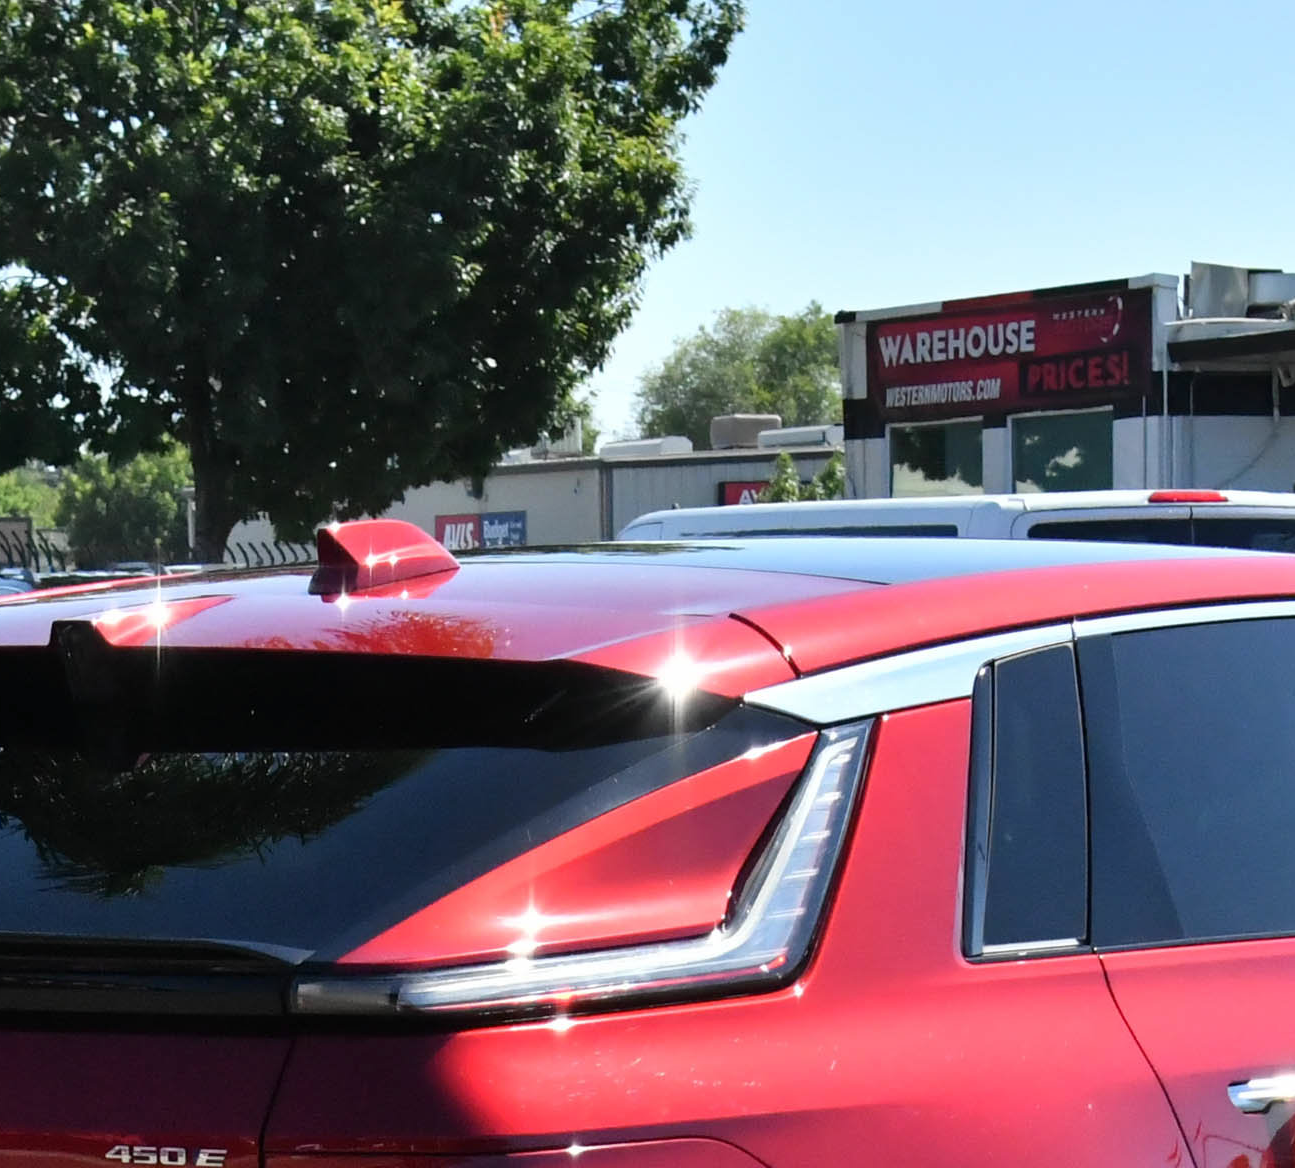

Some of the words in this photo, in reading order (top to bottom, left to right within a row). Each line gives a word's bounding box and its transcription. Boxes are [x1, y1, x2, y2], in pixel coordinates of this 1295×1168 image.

[879, 319, 1036, 368] WAREHOUSE
[1027, 351, 1130, 392] PRICES!
[886, 378, 1002, 408] WESTERNMOTORS.COM
[105, 1145, 186, 1166] 450
[195, 1148, 227, 1167] E
